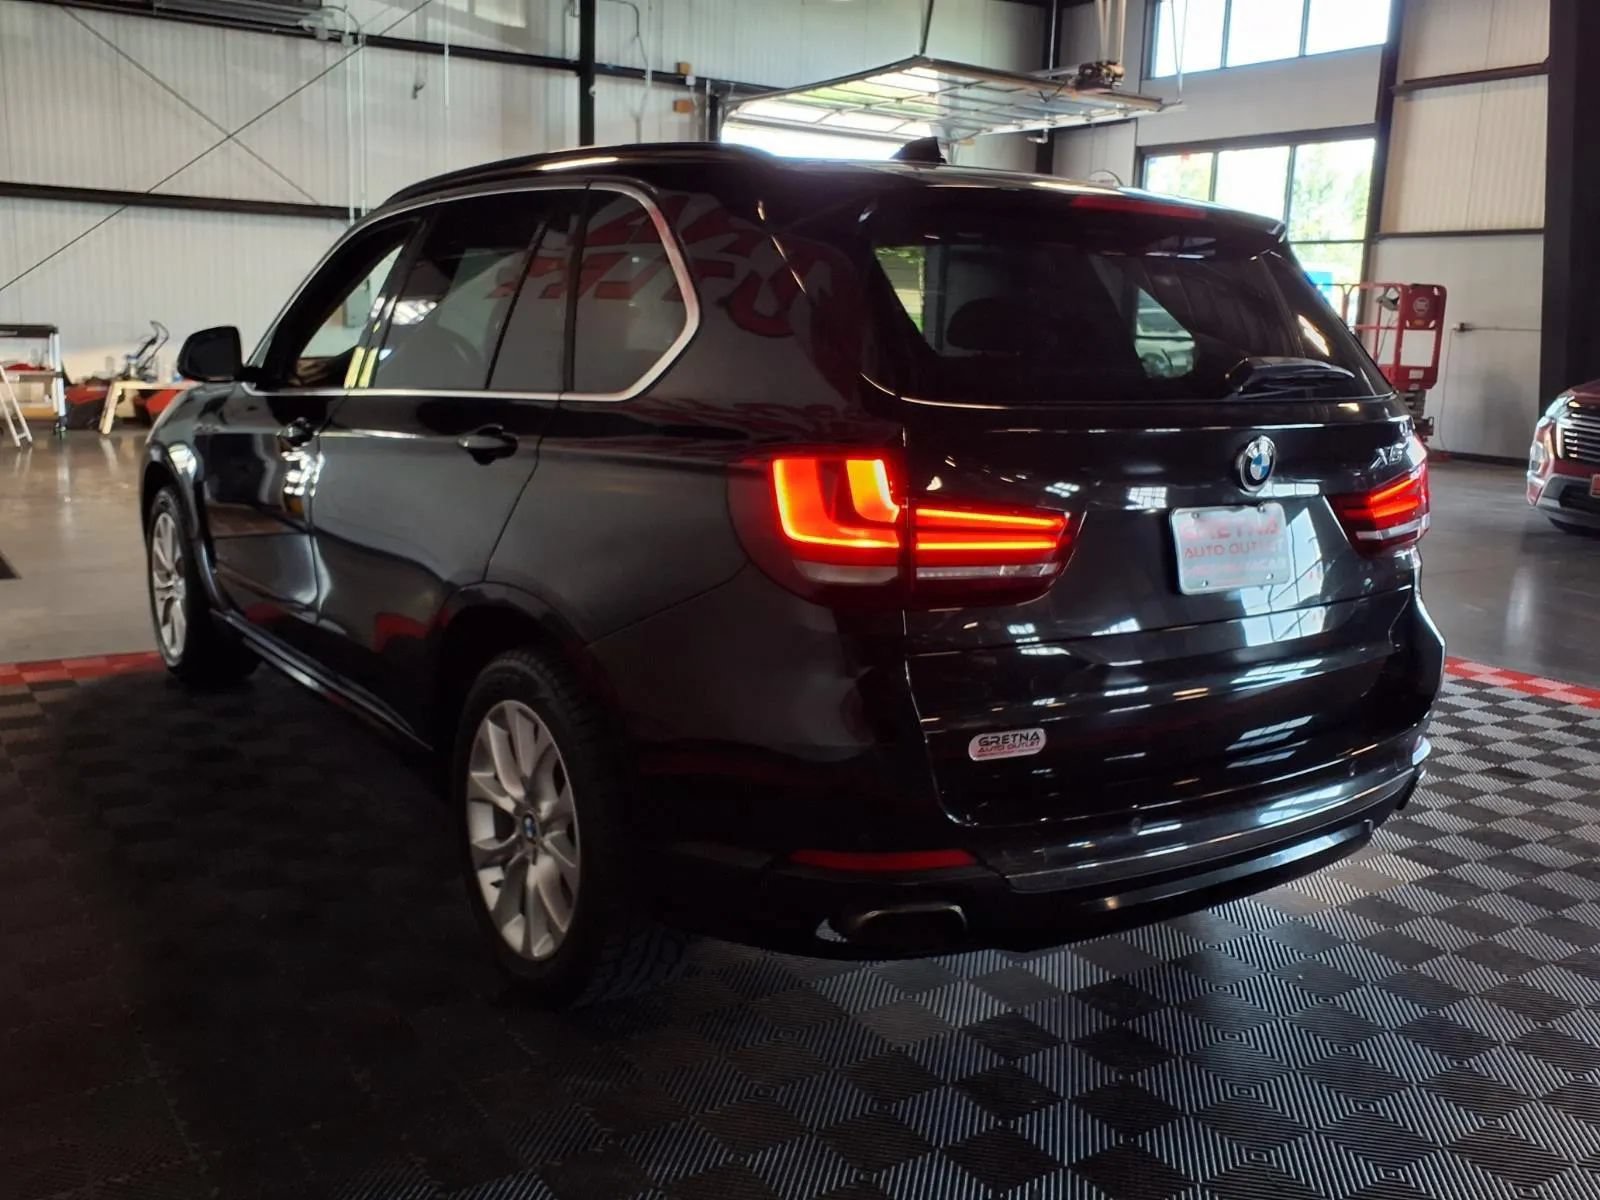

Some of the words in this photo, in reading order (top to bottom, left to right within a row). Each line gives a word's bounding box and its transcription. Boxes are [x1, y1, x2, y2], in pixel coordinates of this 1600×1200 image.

[1184, 544, 1226, 559] AUTO
[977, 731, 1041, 747] GRETNA
[977, 744, 1005, 753] AUTO
[1006, 740, 1040, 750] OUTLET
